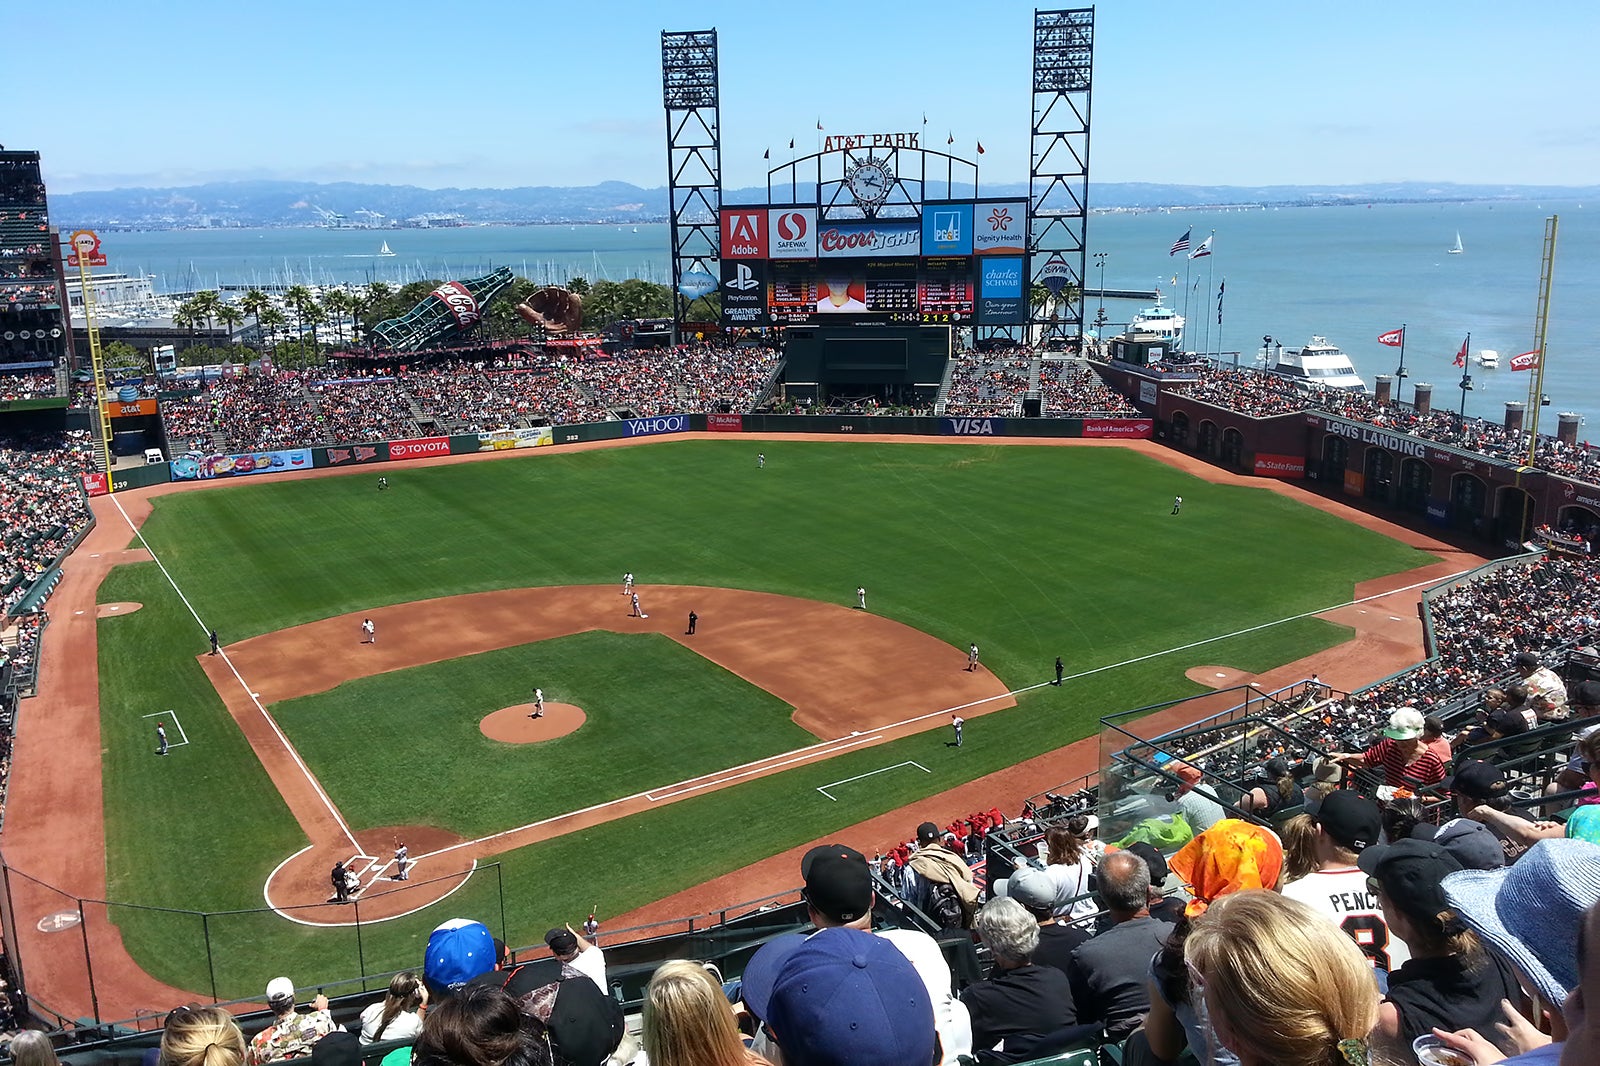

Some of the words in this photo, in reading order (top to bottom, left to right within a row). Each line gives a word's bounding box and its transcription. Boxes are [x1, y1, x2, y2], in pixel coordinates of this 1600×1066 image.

[824, 135, 865, 153] AT&T
[872, 132, 919, 150] PARK
[820, 228, 876, 252] Coors
[869, 229, 920, 251] LIGHT
[936, 229, 959, 240] PG&E
[977, 234, 1000, 243] Dignity
[731, 244, 758, 254] Adobe
[986, 269, 1018, 279] charles
[1045, 265, 1068, 274] RE/MAX
[120, 404, 141, 414] at&t
[628, 416, 684, 435] YAHOO!
[950, 418, 993, 434] VISA
[407, 442, 449, 453] TOYOTA
[1362, 430, 1425, 458] LANDING
[1266, 461, 1285, 470] State
[1286, 464, 1304, 472] Farm
[113, 481, 128, 489] 339
[1340, 914, 1392, 974] 8
